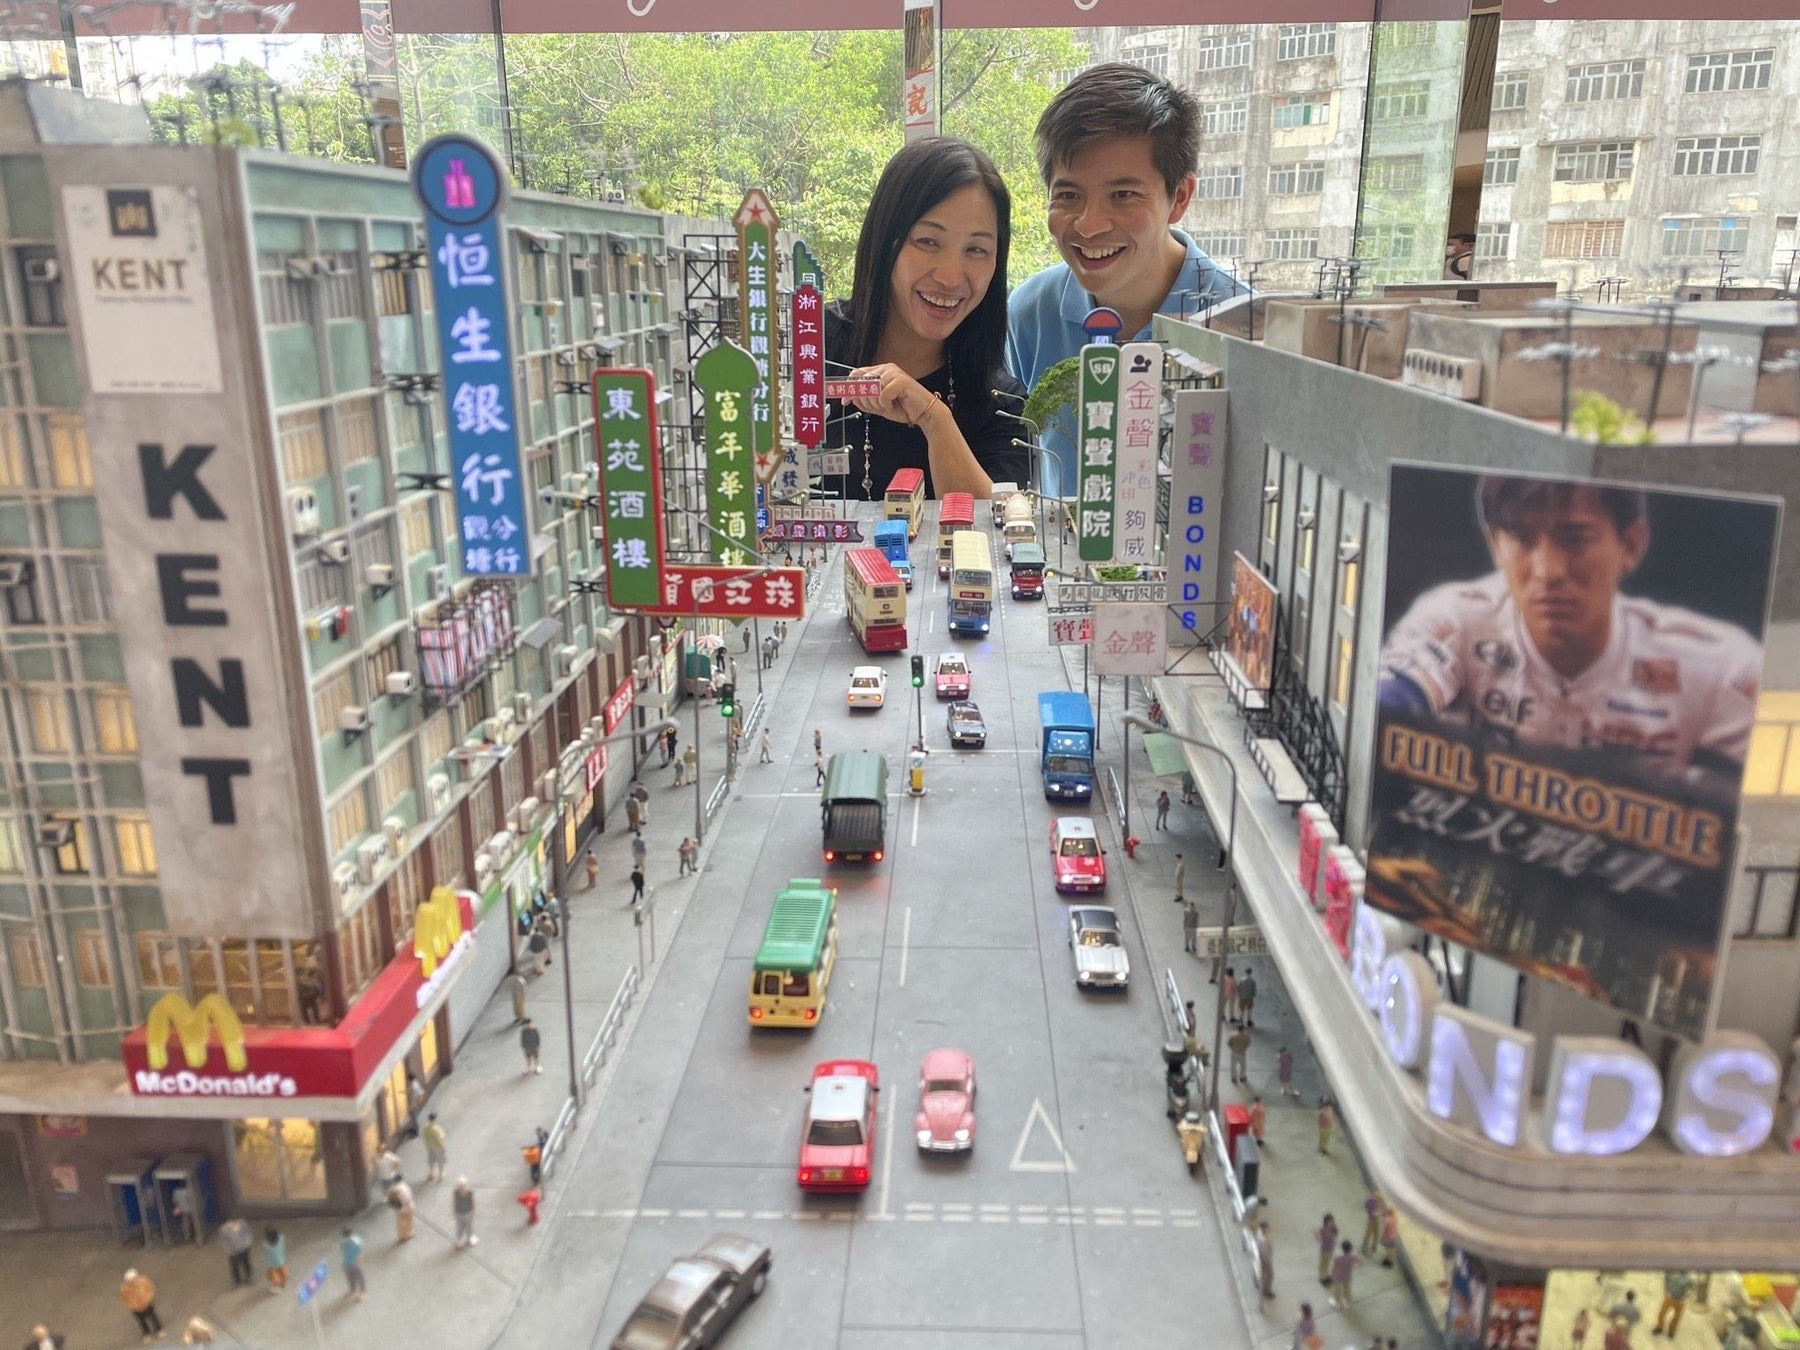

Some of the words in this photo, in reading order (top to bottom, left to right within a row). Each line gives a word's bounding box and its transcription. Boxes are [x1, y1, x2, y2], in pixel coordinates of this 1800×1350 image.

[92, 257, 188, 290] KENT
[438, 232, 513, 506] 恒生銀行
[1125, 380, 1155, 448] 金聲
[603, 387, 651, 569] 東苑酒樓
[1082, 400, 1115, 539] 寶聲戲院
[1181, 496, 1205, 630] BONDS
[137, 444, 251, 825] KENT
[1102, 630, 1157, 656] 金聲
[1381, 724, 1478, 794] FULL
[1484, 753, 1724, 869] THROTTLE
[135, 1070, 297, 1096] McDonald's
[1352, 898, 1778, 1157] BONDS
